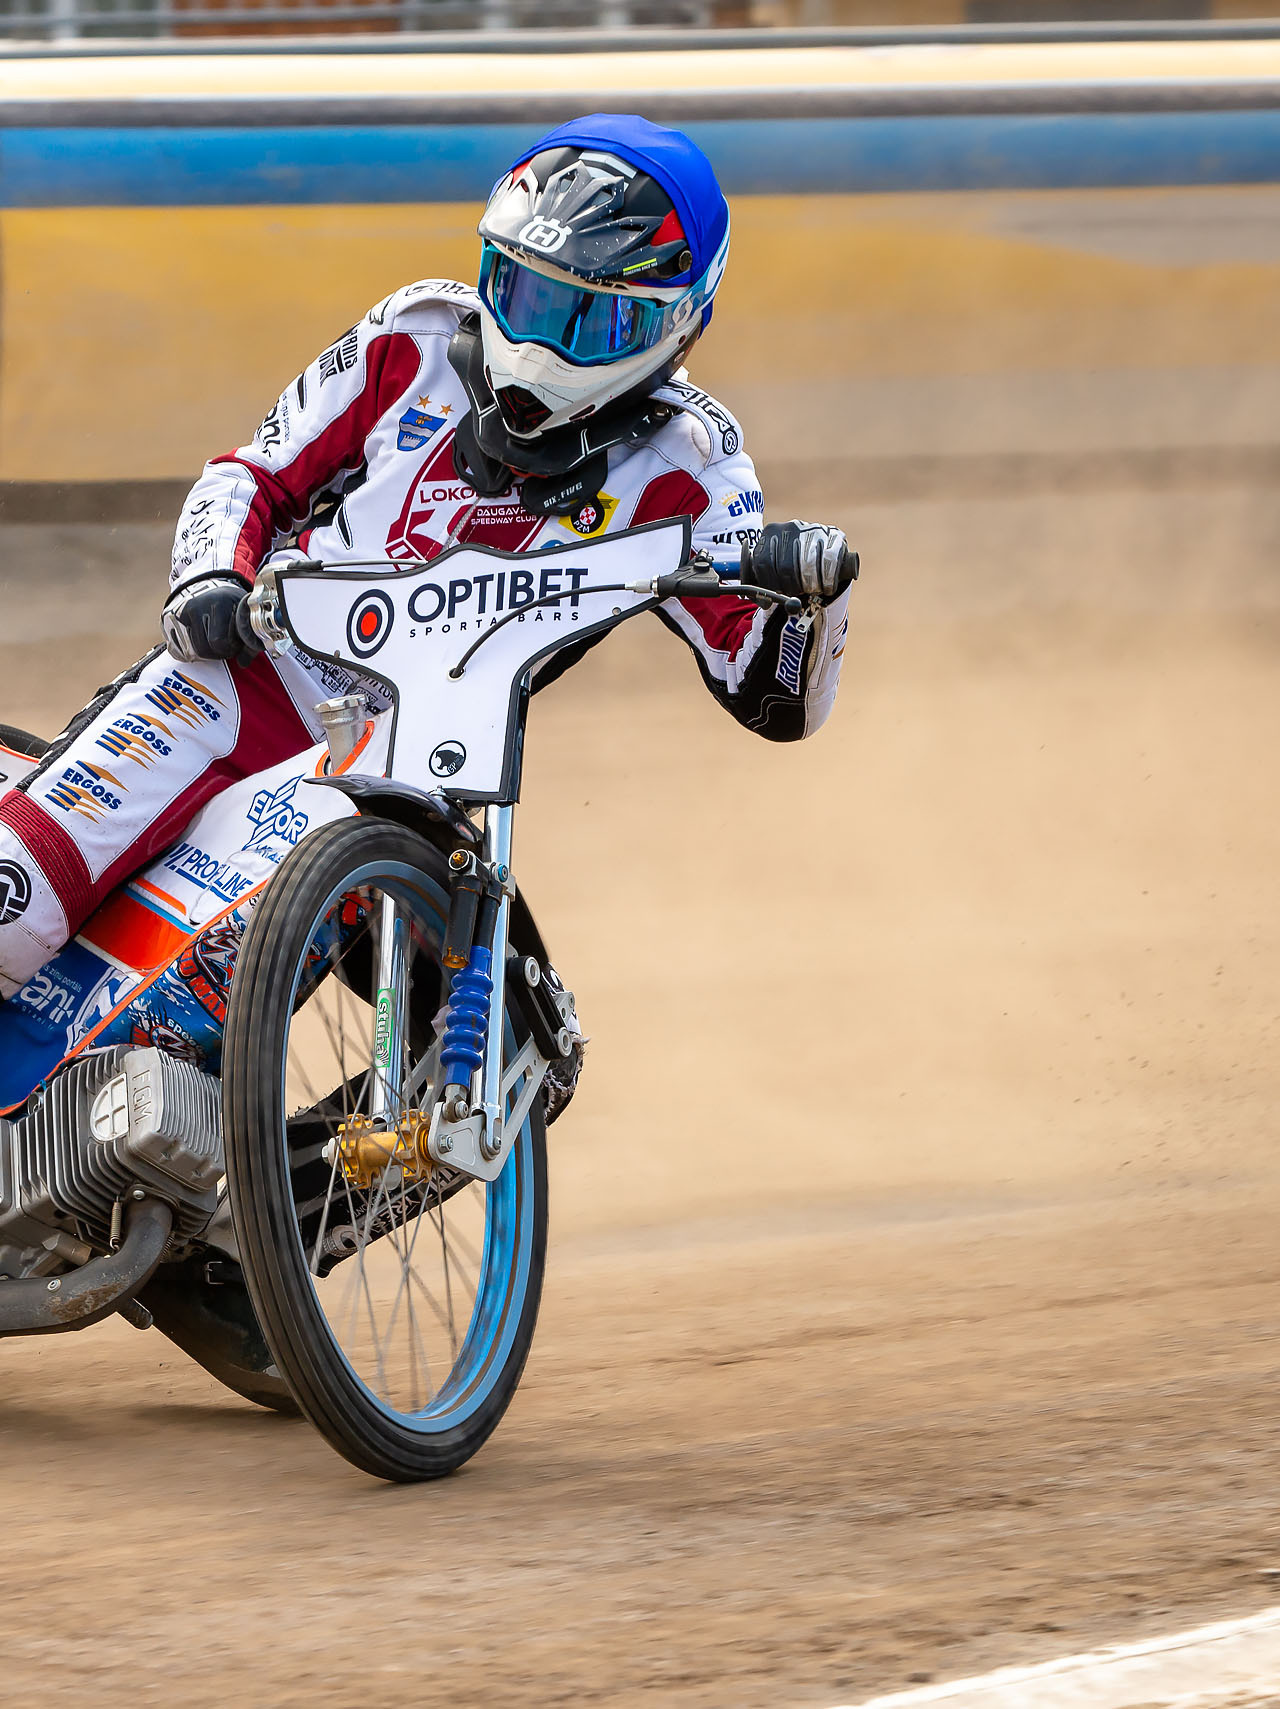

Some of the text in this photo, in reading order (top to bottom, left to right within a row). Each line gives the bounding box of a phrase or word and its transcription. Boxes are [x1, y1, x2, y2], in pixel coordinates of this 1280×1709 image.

[471, 515, 537, 525] SPEEDWAY CLUB
[573, 520, 590, 533] PZM
[408, 568, 588, 623] OPTIBET
[410, 610, 579, 637] SPORTA BĀRS
[163, 677, 221, 721] ERGOSS
[113, 719, 172, 757] ERGOSS
[62, 768, 122, 810] ERGOSS
[247, 789, 309, 845] EVOR
[376, 1001, 390, 1055] stuha
